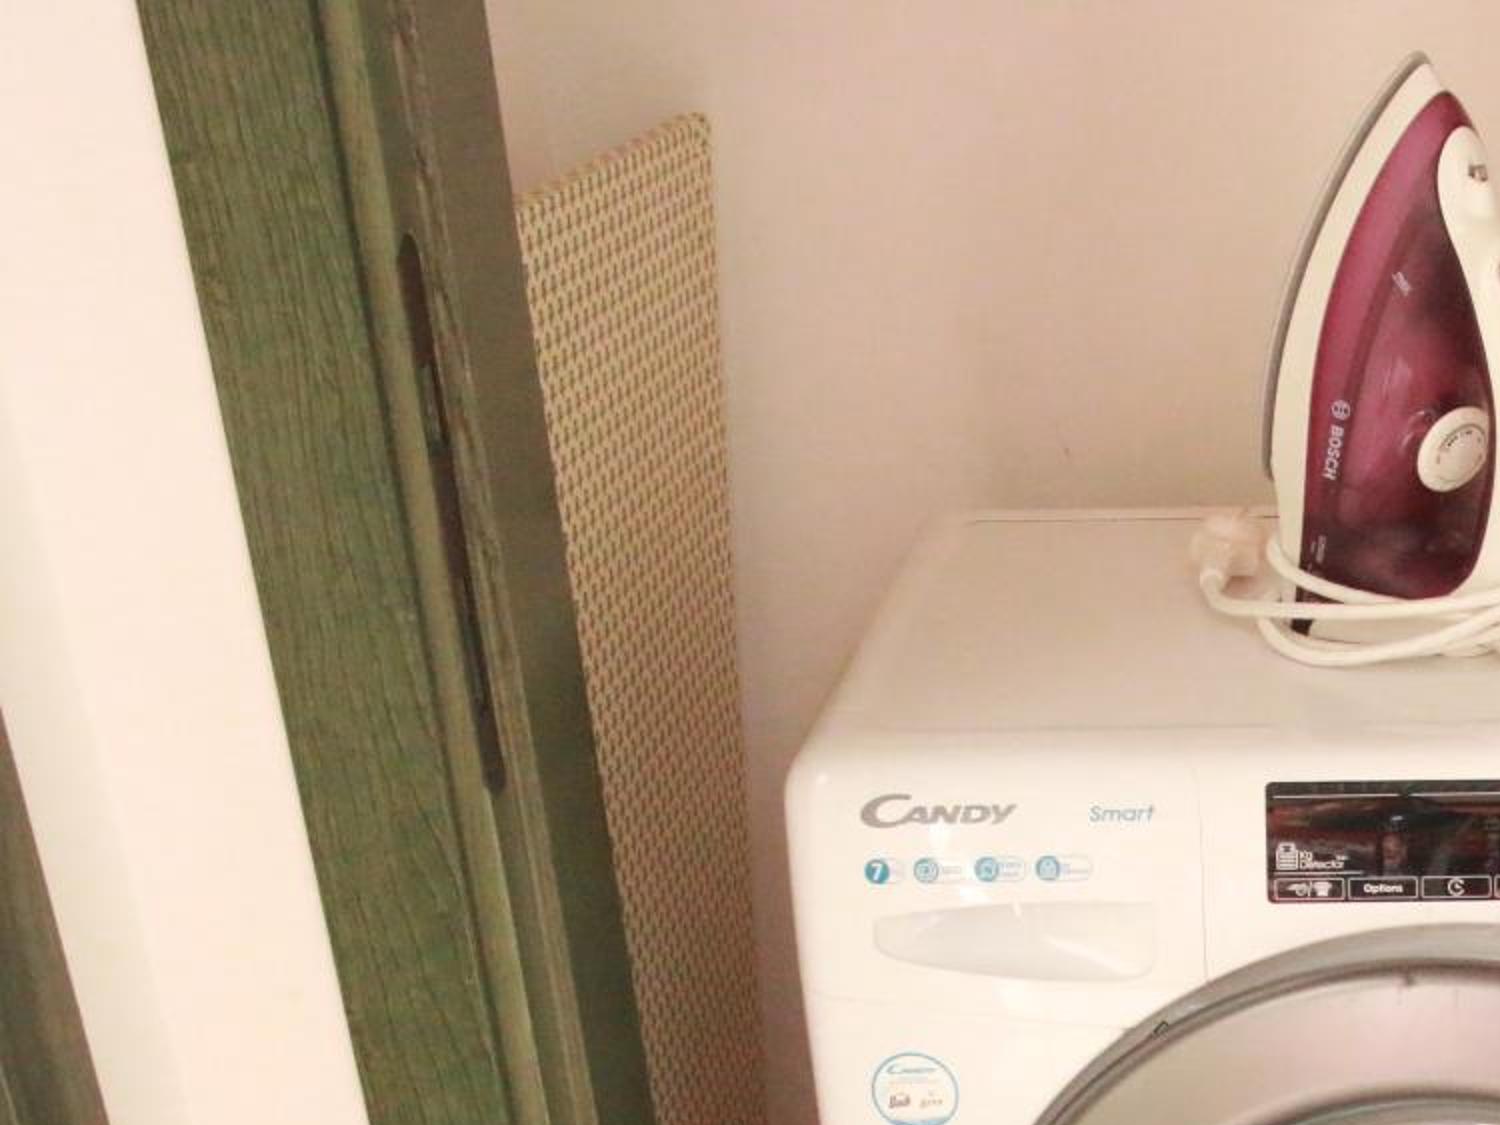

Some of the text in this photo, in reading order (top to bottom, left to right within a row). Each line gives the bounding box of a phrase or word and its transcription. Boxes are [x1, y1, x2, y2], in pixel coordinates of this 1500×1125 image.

[1322, 424, 1344, 481] BOSCH
[860, 793, 1017, 828] CANDY
[1089, 805, 1155, 823] Smart
[1363, 883, 1404, 894] Options
